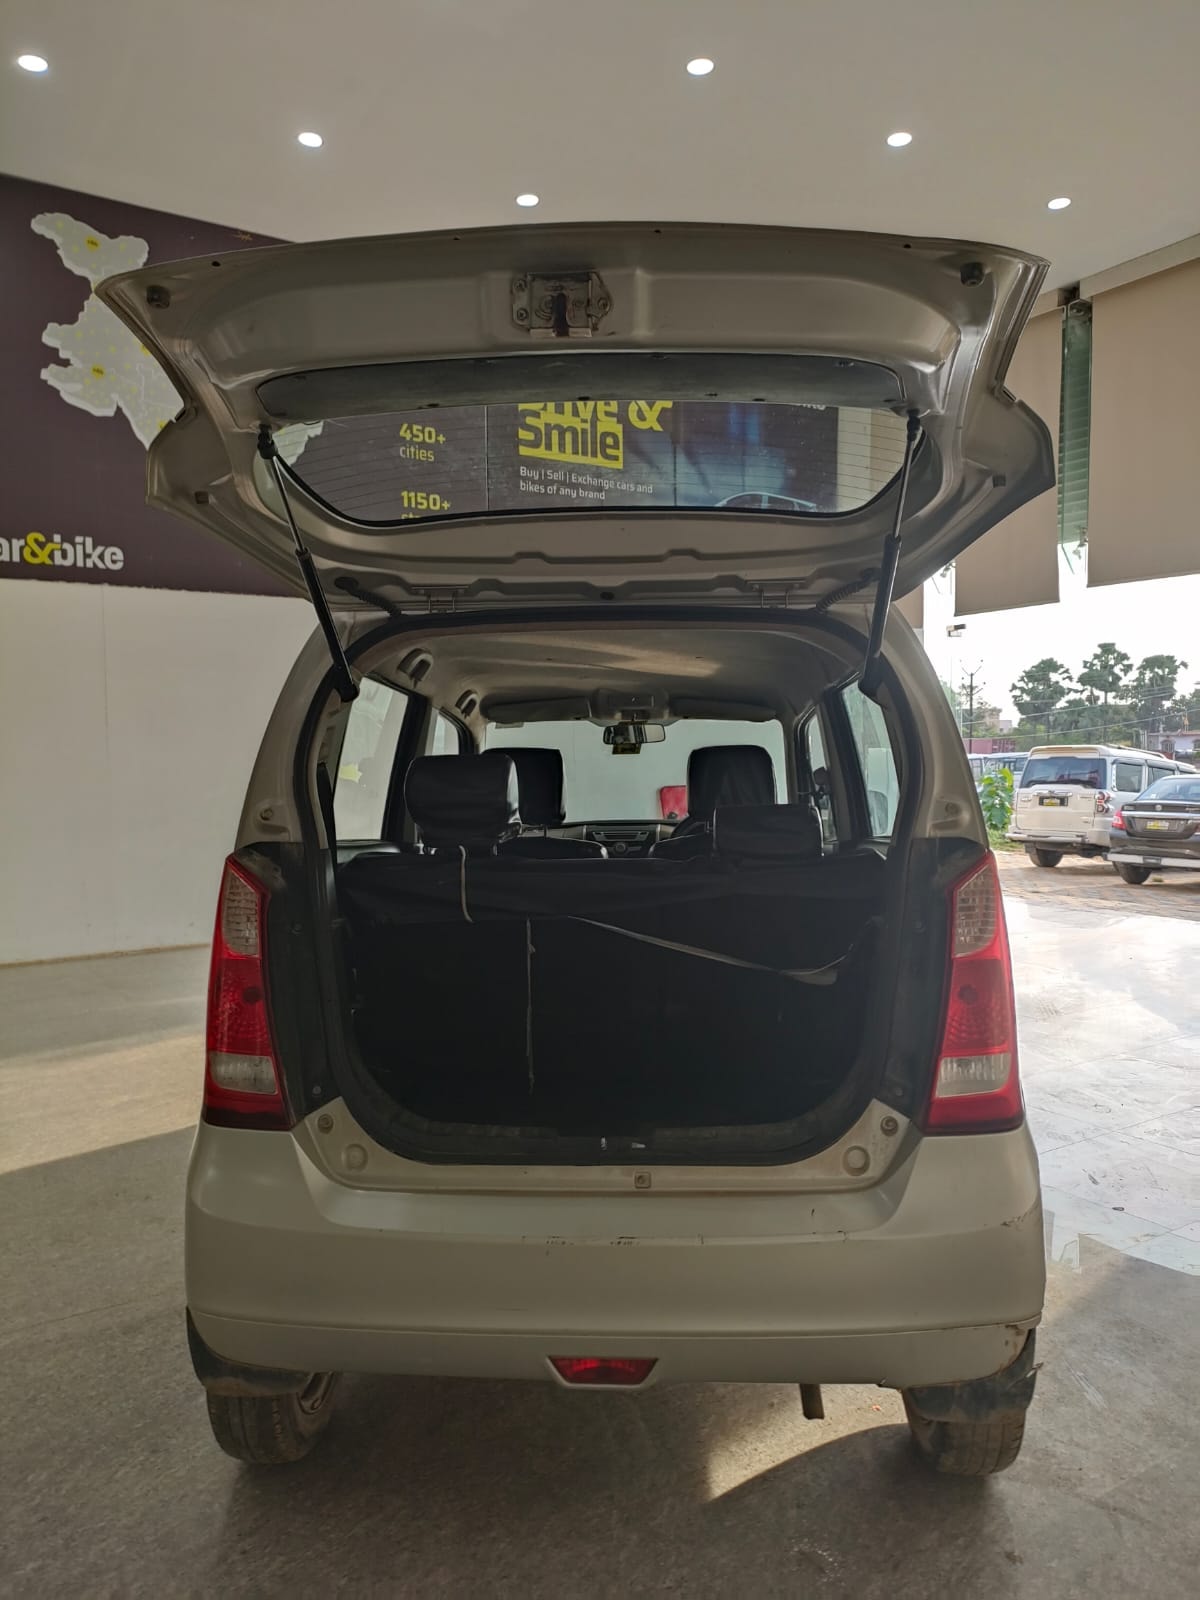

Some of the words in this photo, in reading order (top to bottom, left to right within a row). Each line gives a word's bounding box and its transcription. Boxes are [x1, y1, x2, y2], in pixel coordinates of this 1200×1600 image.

[400, 423, 446, 444] 450+
[518, 409, 620, 462] Smile
[400, 444, 435, 462] cities
[520, 466, 539, 480] Buy
[547, 470, 564, 481] Sell
[571, 473, 615, 490] Exchange
[617, 480, 635, 492] cars
[637, 484, 653, 494] and
[520, 480, 545, 494] bikes
[547, 484, 557, 495] of
[560, 486, 577, 498] any
[579, 488, 606, 500] brand
[401, 490, 450, 511] 1150+
